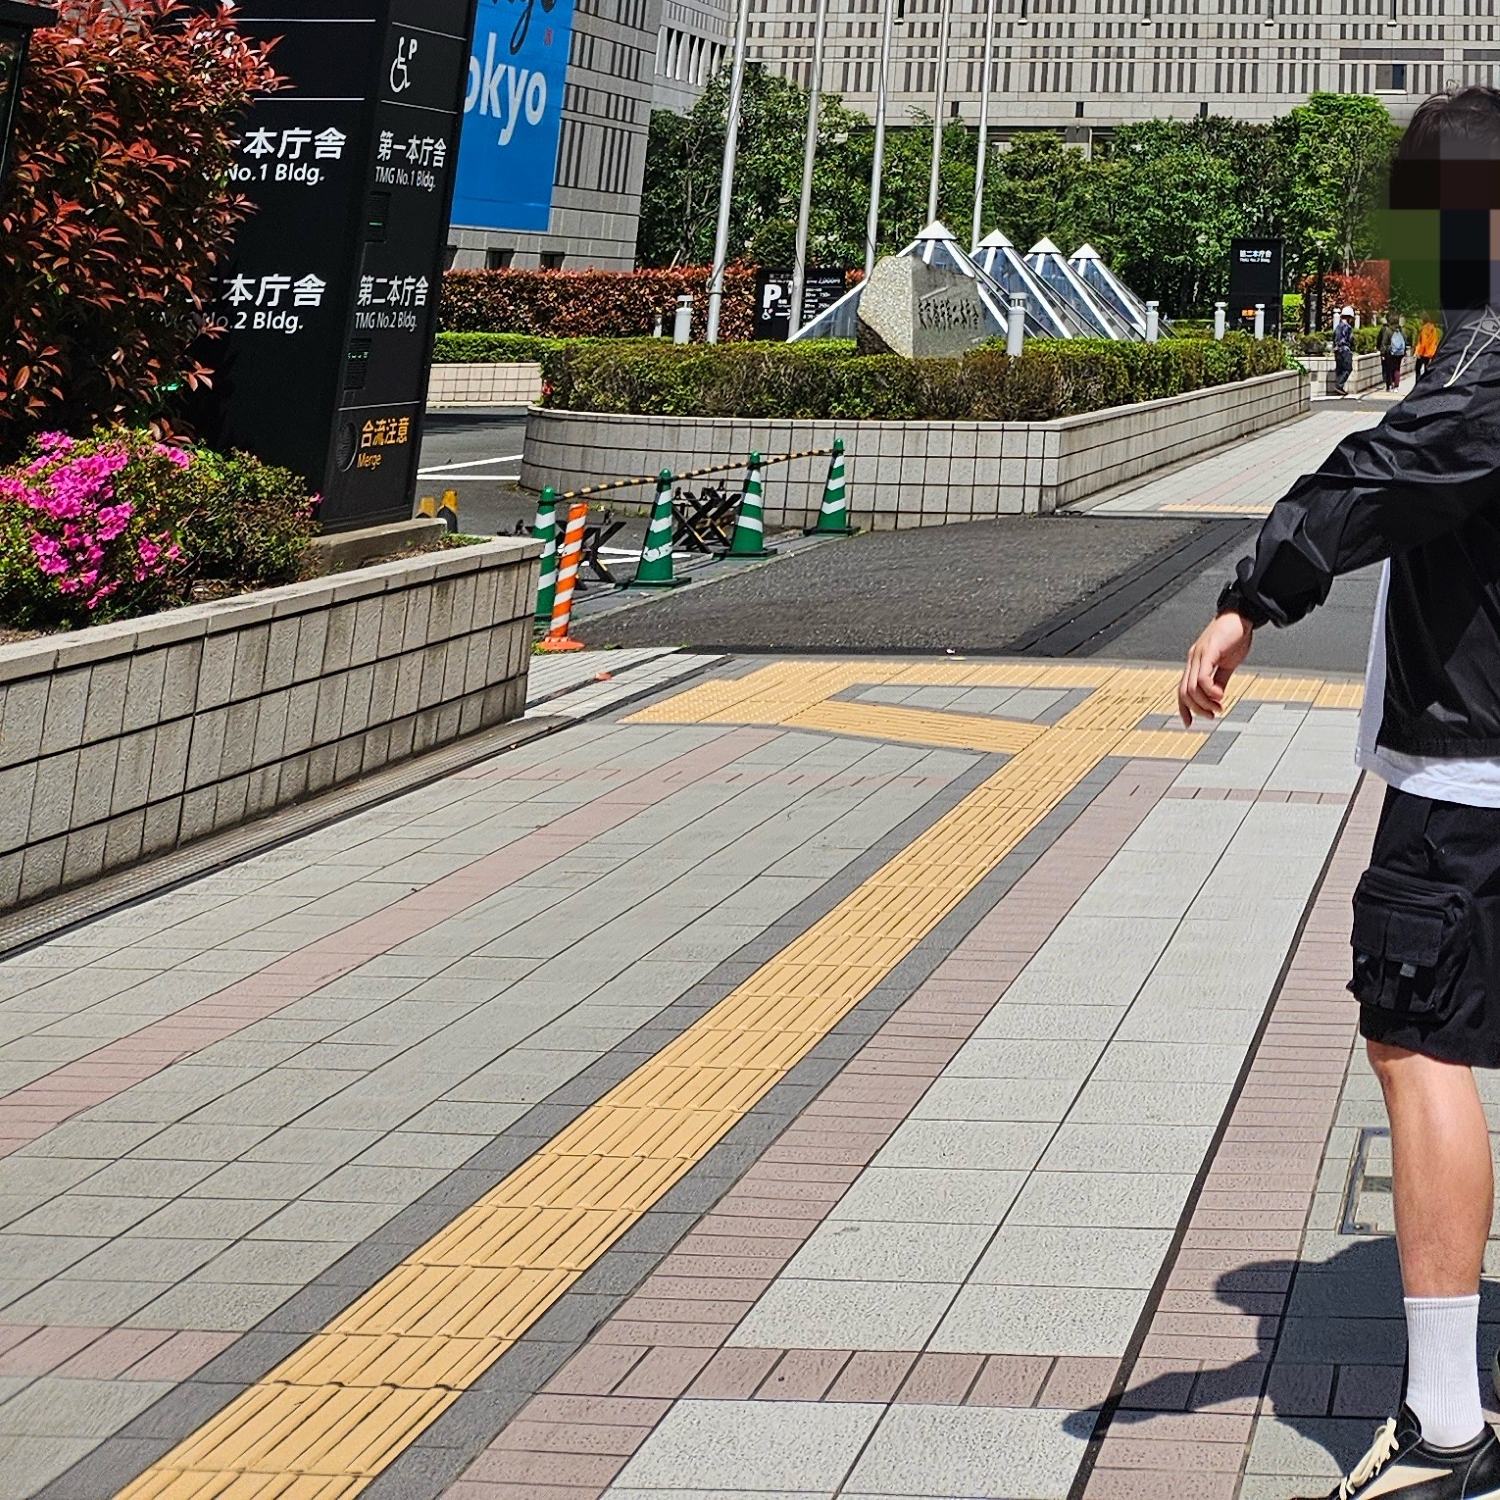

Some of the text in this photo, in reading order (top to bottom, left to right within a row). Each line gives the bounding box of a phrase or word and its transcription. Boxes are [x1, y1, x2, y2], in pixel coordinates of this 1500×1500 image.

[464, 32, 547, 146] okyo
[230, 127, 347, 160] 本庁舎
[376, 130, 447, 168] 第一本庁舎
[275, 163, 326, 186] Bldg.
[375, 166, 436, 192] TMG No.1 Bldg.
[209, 273, 327, 307] 本庁舎
[356, 274, 429, 307] 第二本庁舎
[763, 284, 781, 308] P
[253, 311, 304, 334] Bldg.
[355, 310, 417, 332] TMG No.2 Bldg.
[360, 417, 410, 449] 合流注意
[356, 453, 382, 470] Merge
